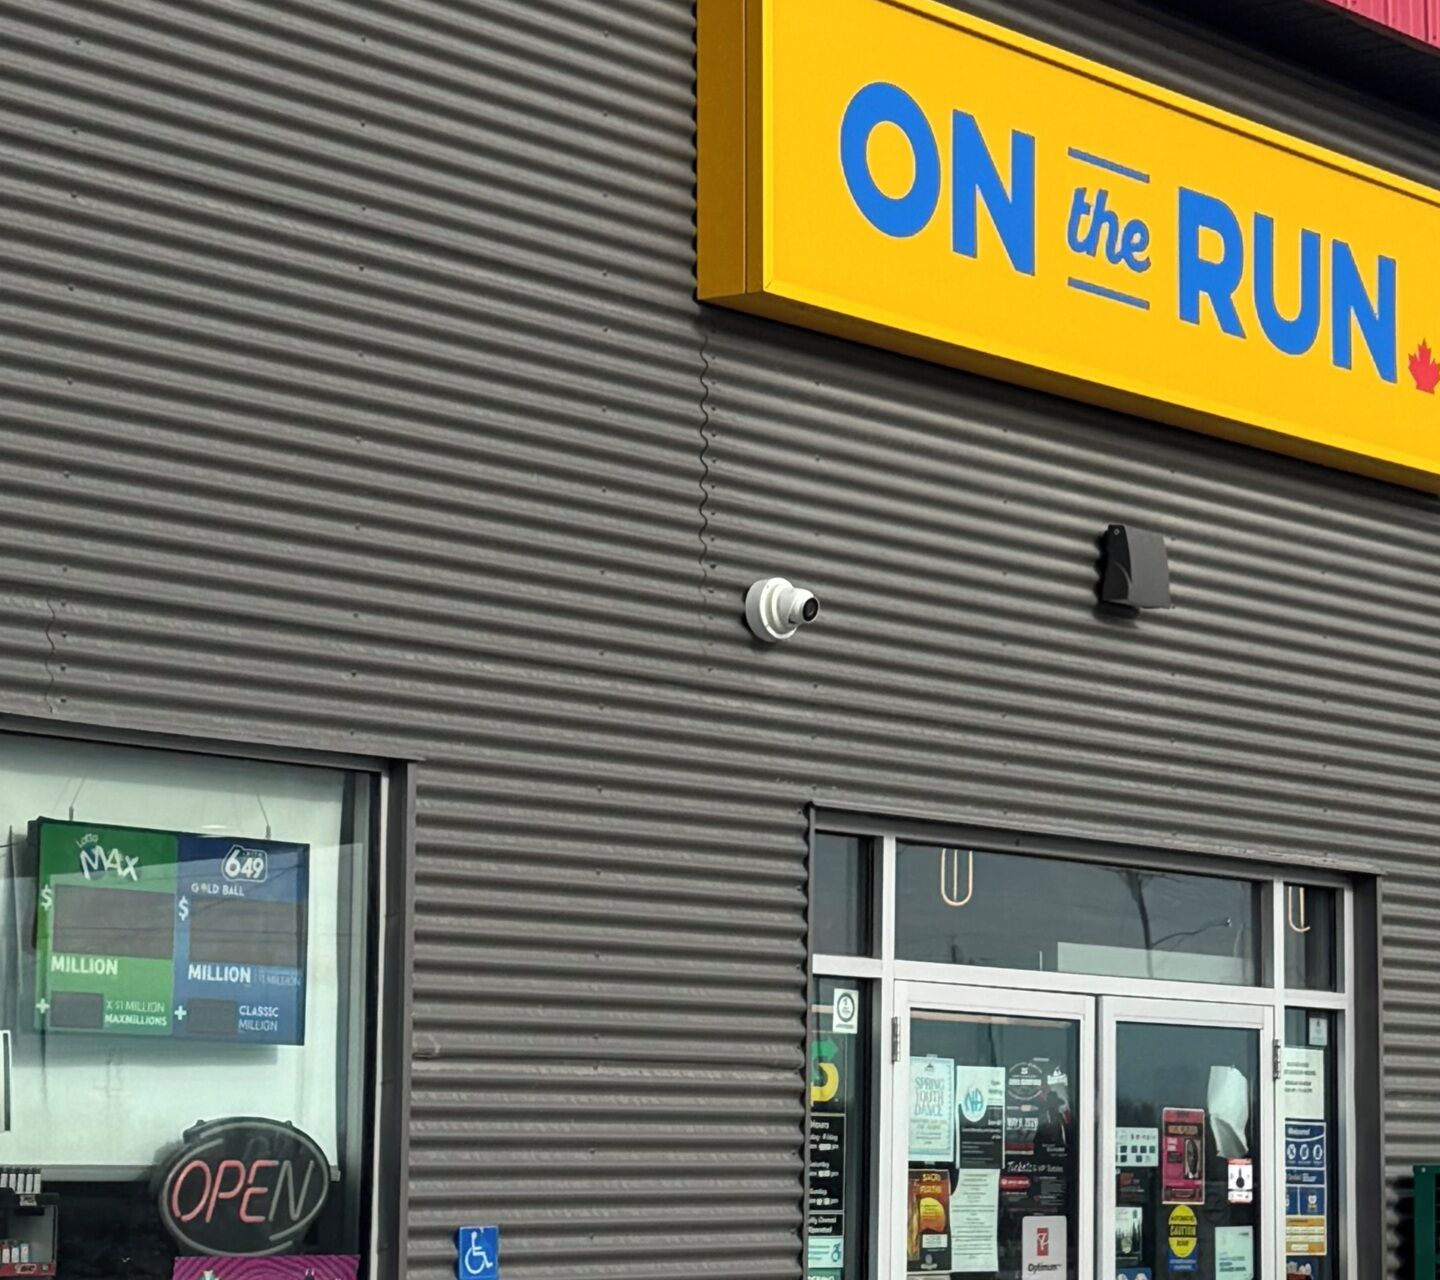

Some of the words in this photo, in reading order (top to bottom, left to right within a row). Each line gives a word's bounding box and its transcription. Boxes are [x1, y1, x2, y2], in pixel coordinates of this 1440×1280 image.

[840, 81, 1035, 276] ON
[1067, 186, 1152, 273] the
[1178, 186, 1398, 384] RUN
[80, 845, 139, 882] MAX
[41, 884, 52, 910] $
[222, 884, 245, 897] BALL
[179, 896, 188, 921] $
[51, 955, 118, 976] MILLION
[188, 964, 250, 984] MILLION
[123, 1001, 164, 1013] MILLION
[239, 1005, 279, 1018] CLASSIC
[105, 1014, 167, 1027] MAXMILLIONS
[239, 1019, 278, 1032] MILLION
[172, 1159, 315, 1223] OPEN
